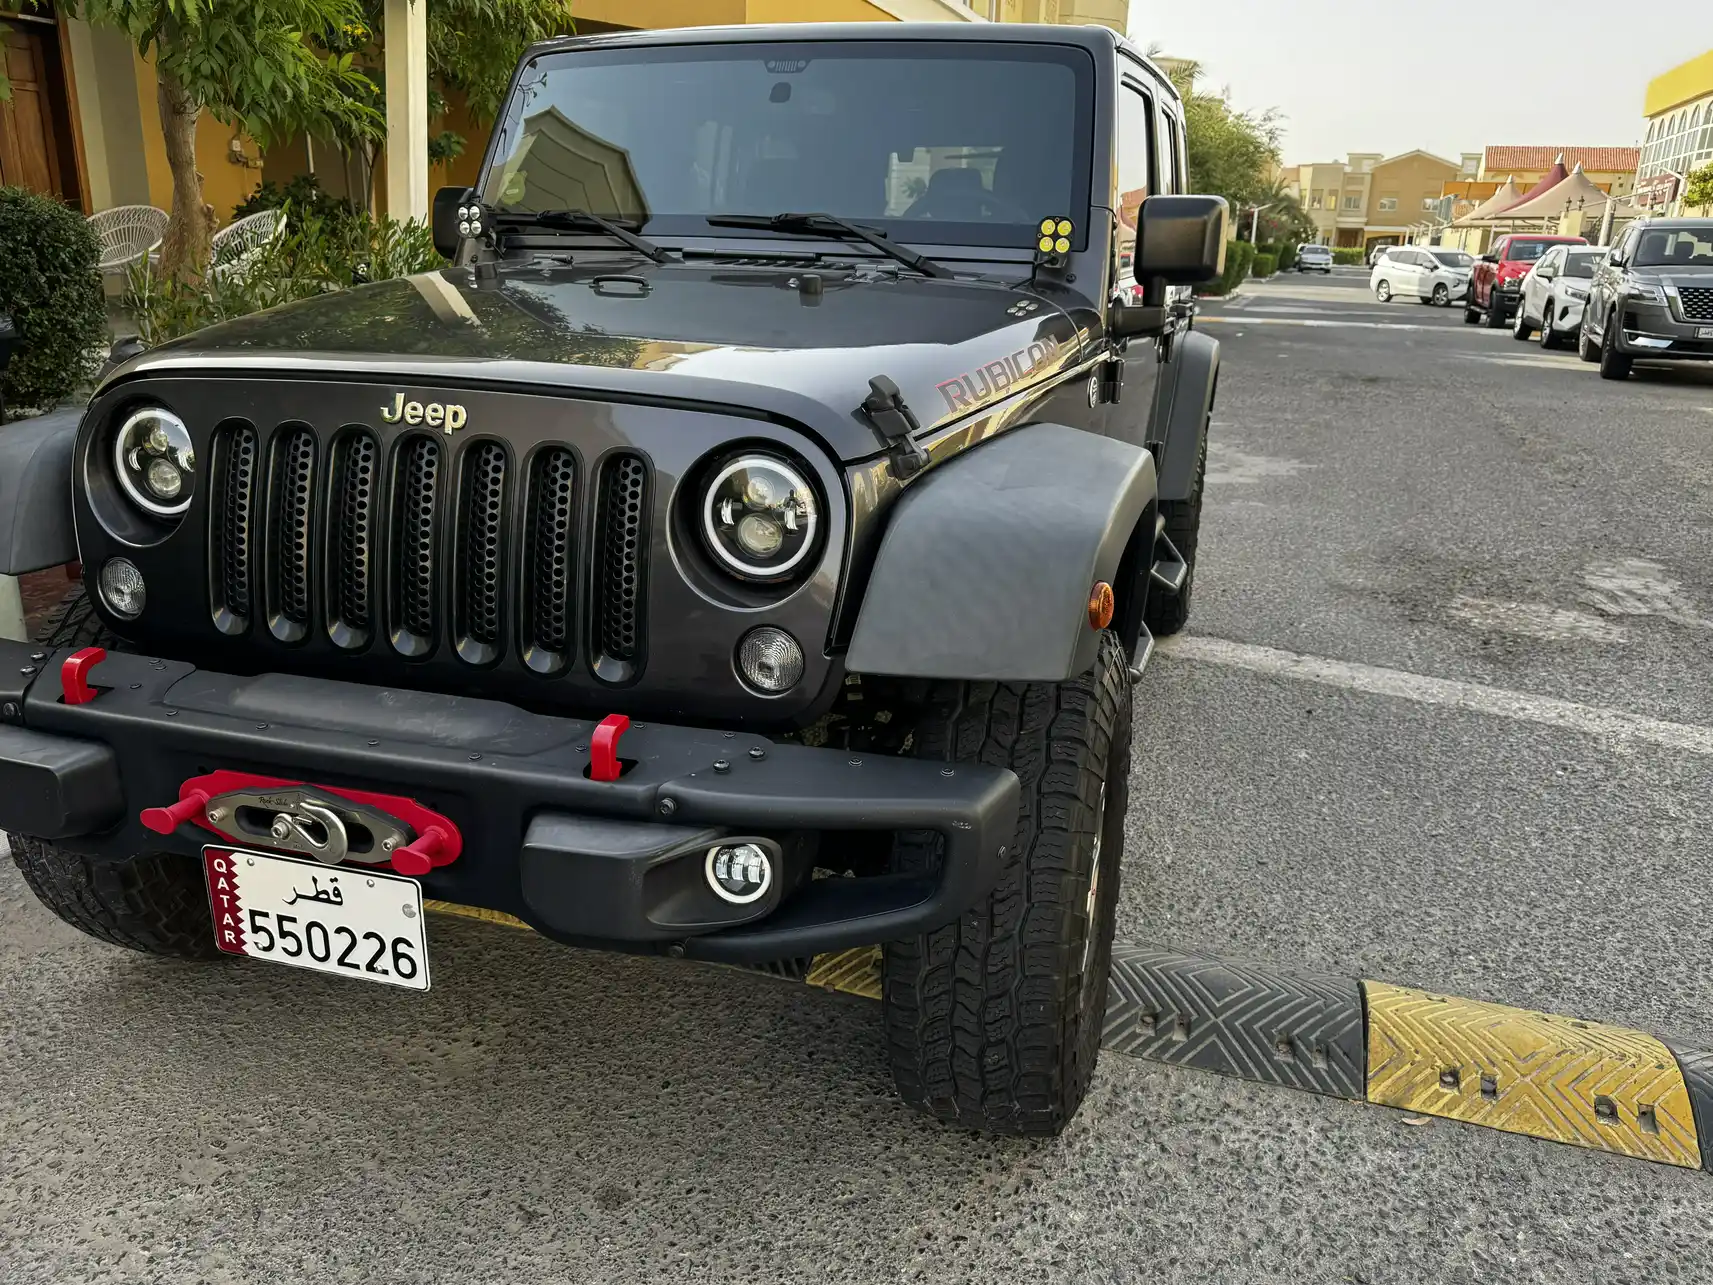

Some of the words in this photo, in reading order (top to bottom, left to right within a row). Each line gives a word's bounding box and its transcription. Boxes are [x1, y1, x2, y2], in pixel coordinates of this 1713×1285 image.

[935, 334, 1061, 413] RUBICON
[380, 392, 467, 435] Jeep
[213, 858, 237, 944] QATAR
[282, 875, 344, 906] قطر
[248, 908, 418, 980] 550226
